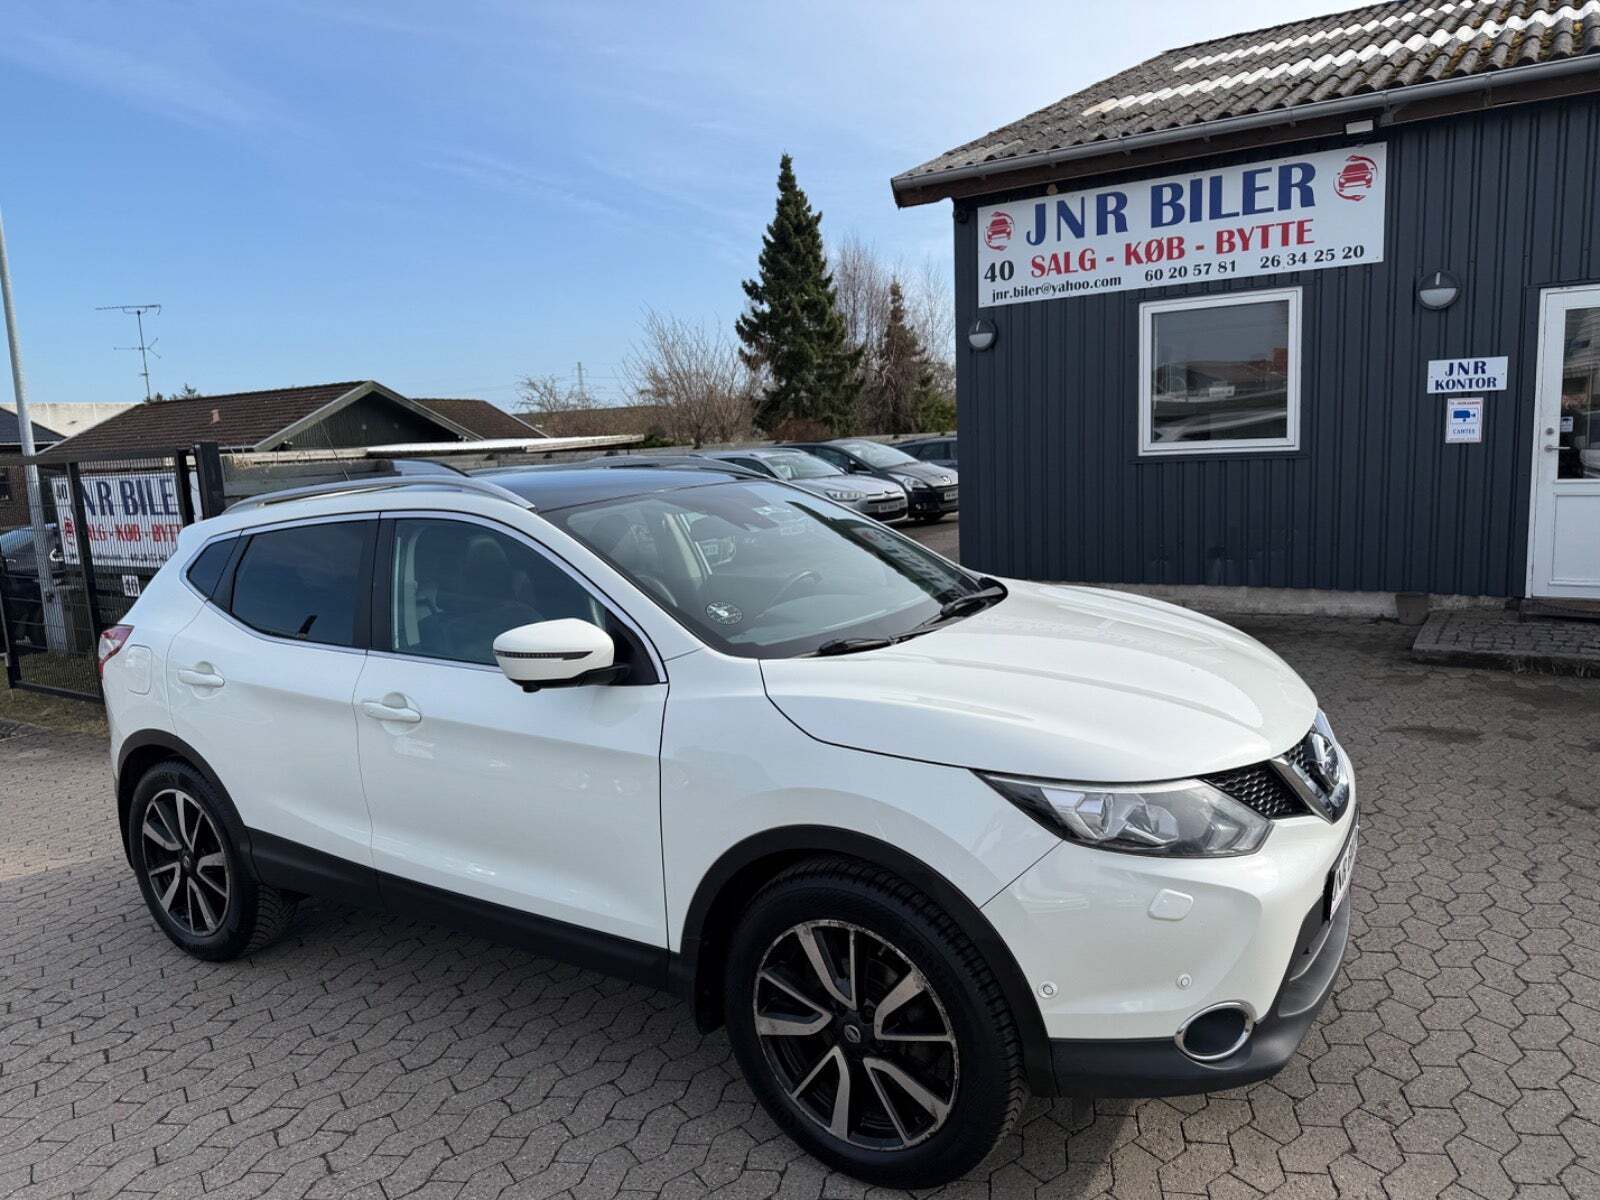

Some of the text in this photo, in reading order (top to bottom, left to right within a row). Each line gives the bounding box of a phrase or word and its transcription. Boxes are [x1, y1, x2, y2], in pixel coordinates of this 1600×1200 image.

[1025, 161, 1317, 247] JNR BILER
[1031, 248, 1097, 278] SALG
[1124, 236, 1186, 266] KØB
[1215, 218, 1316, 255] BYTTE
[1259, 244, 1365, 270] 26 34 25 20
[983, 259, 1015, 283] 40
[1144, 259, 1237, 282] 60 20 57 81
[991, 275, 1122, 303] jnr.biler@yahoo.com
[1445, 360, 1487, 377] JNR
[1434, 376, 1497, 391] KONTOR
[80, 476, 179, 517] NR BILE
